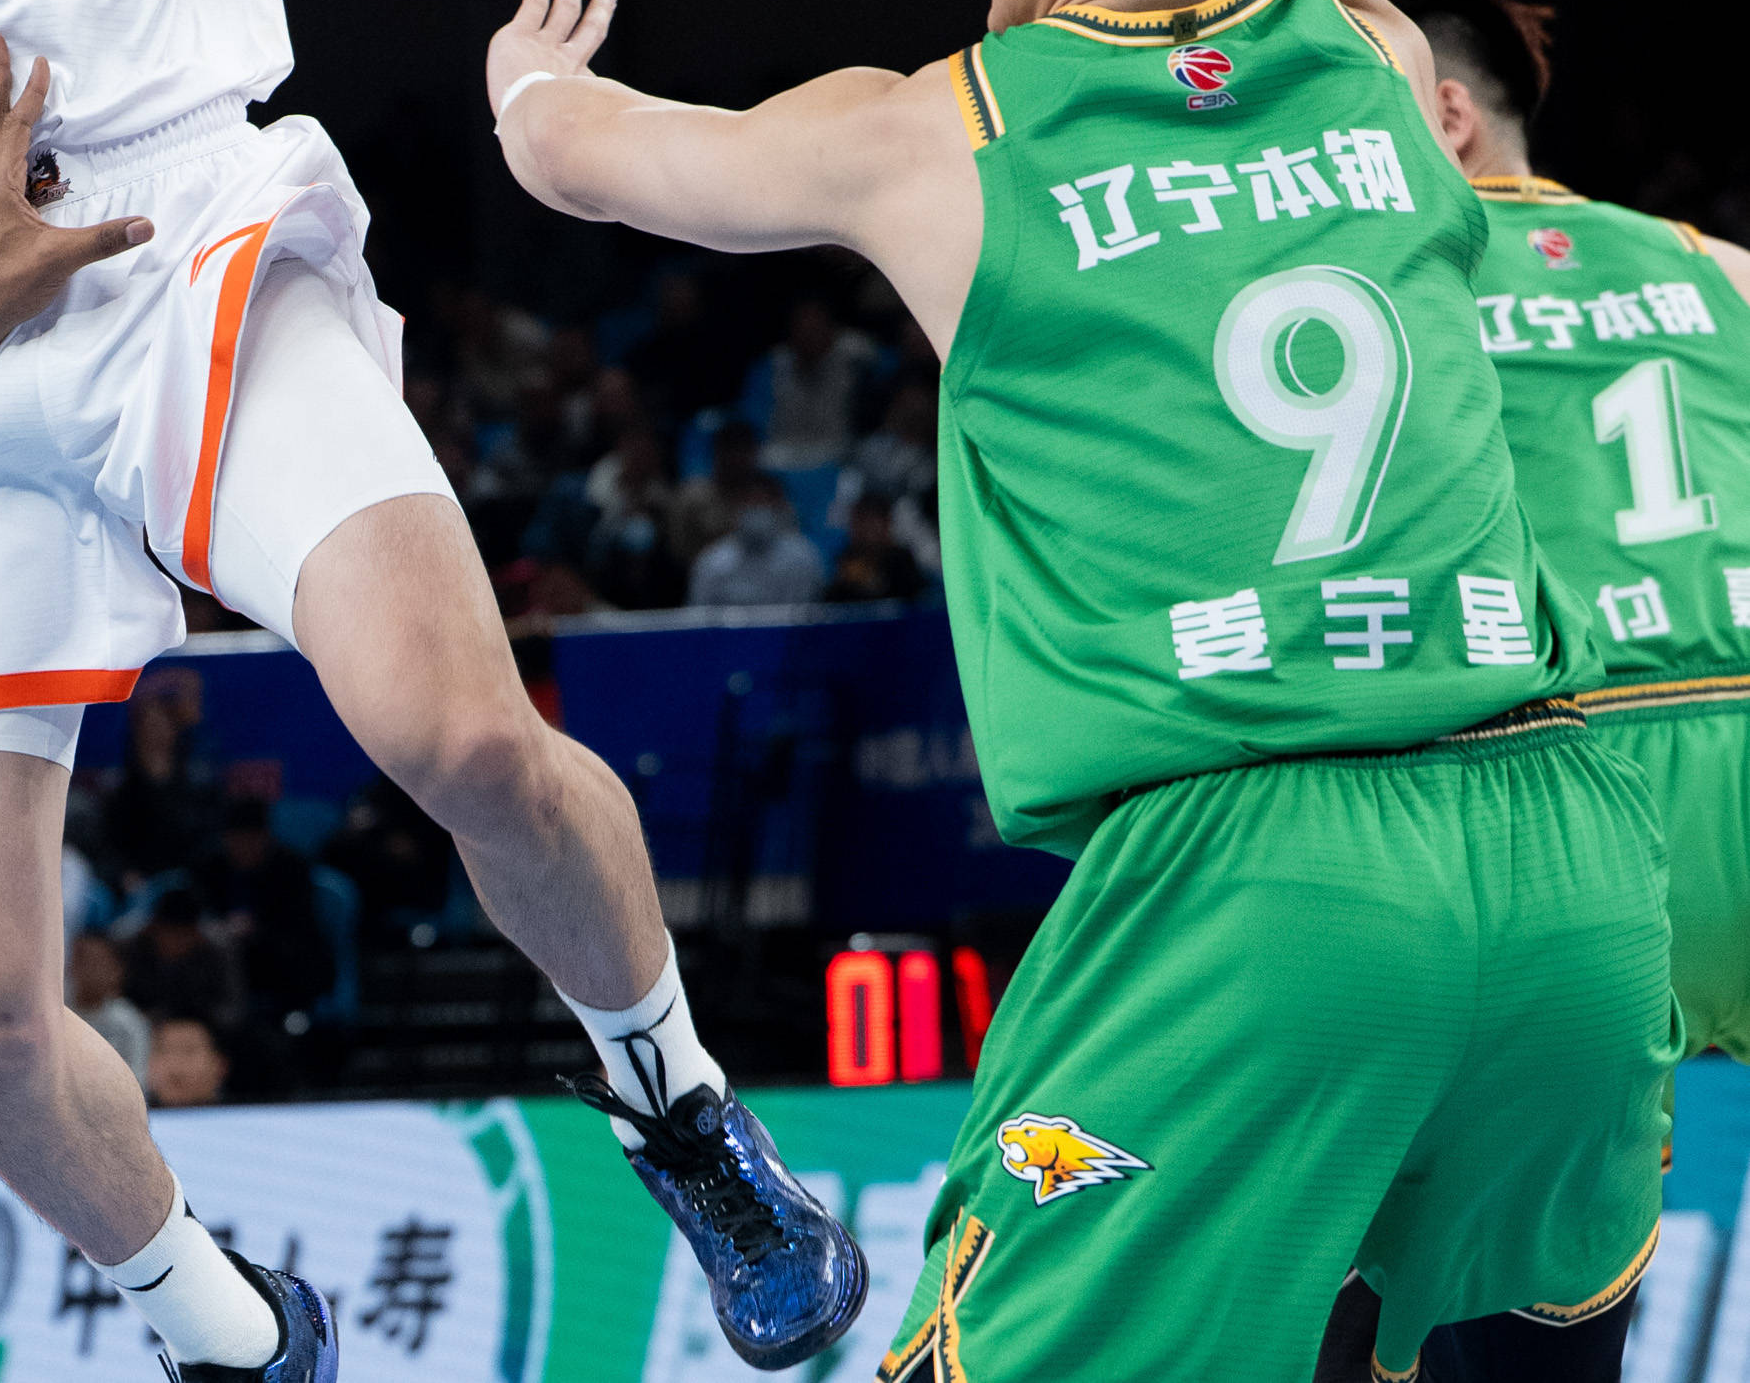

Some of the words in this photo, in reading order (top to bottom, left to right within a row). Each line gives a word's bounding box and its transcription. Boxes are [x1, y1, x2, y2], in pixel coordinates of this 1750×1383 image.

[1186, 91, 1238, 111] CBA
[1049, 128, 1416, 271] 辽宁本钢
[1213, 265, 1413, 566] 9
[1592, 358, 1719, 546] 1
[1169, 576, 1537, 680] 姜宇星
[58, 1213, 454, 1359] 中寿
